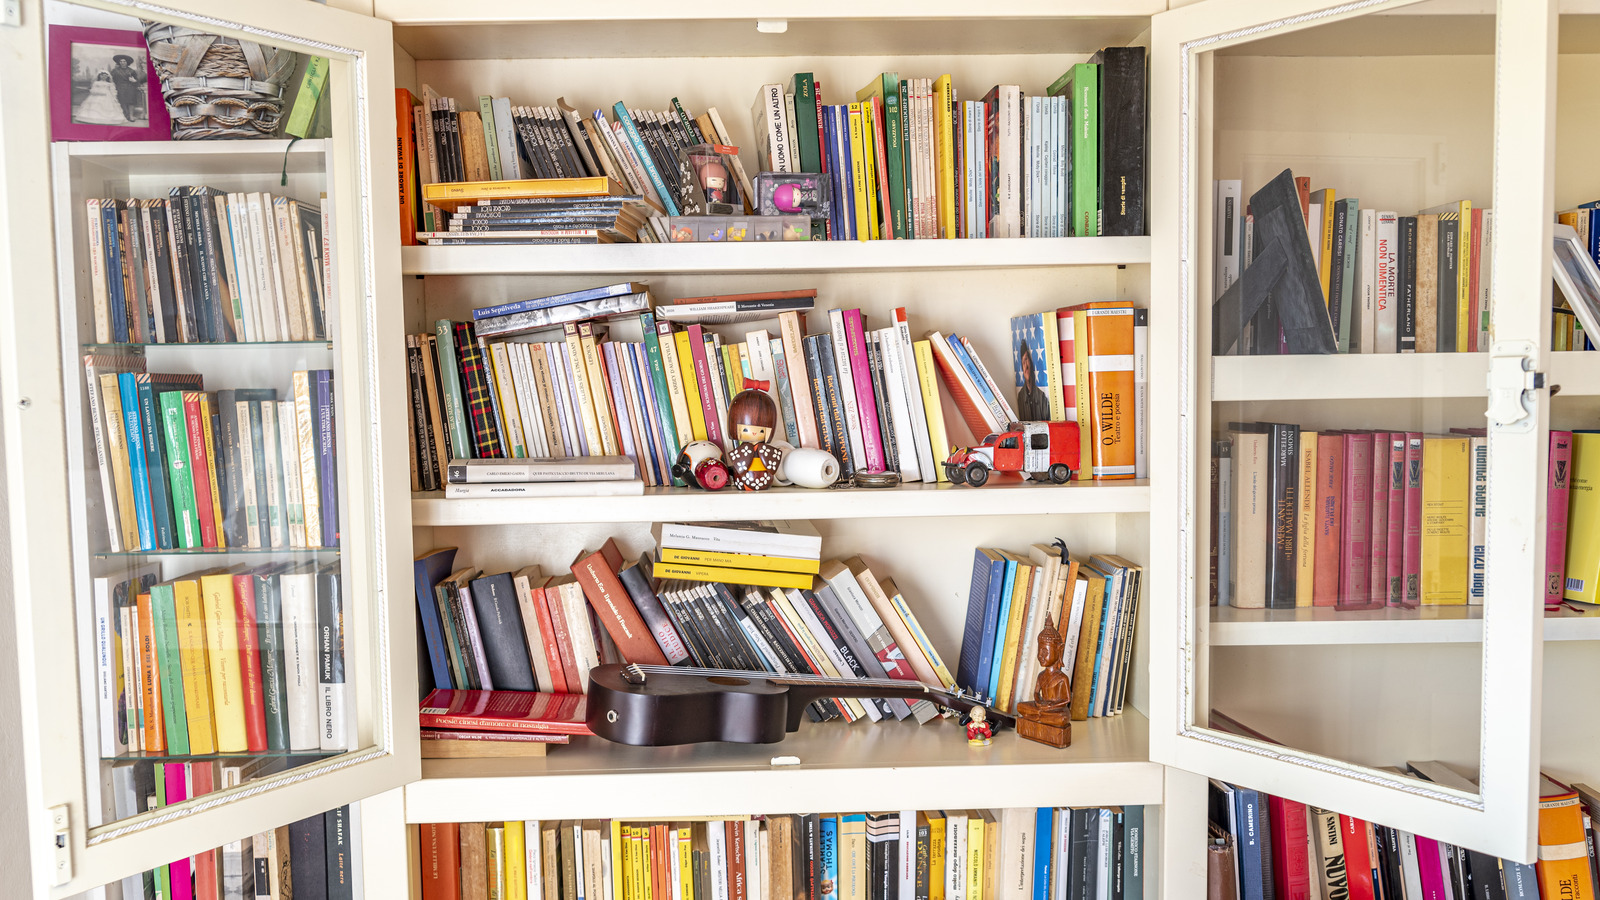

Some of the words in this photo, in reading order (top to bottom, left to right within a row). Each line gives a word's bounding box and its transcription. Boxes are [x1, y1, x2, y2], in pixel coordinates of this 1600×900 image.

[771, 88, 779, 109] ALTRO
[680, 112, 695, 137] CONRAD
[773, 110, 781, 119] UN
[775, 122, 783, 142] COME
[622, 115, 640, 144] coraggio,
[637, 144, 652, 166] charlie
[650, 166, 663, 188] brown!
[776, 144, 785, 164] UOMO
[400, 196, 404, 204] UN
[1379, 239, 1387, 259] NON
[1388, 252, 1396, 263] LA
[1378, 263, 1387, 311] DIMENTICA
[491, 303, 521, 315] Sepúlveda
[437, 325, 448, 335] 33
[848, 316, 859, 356] SHAKESPEARE
[703, 384, 711, 403] SCHIUMA
[1101, 392, 1113, 432] WILDE
[95, 427, 104, 466] STRANALANDIA
[1102, 434, 1114, 446] O.
[1301, 521, 1309, 535] figlia
[586, 563, 600, 584] Umberto
[605, 600, 618, 616] pendolo
[619, 620, 633, 639] Foucault
[750, 609, 765, 625] CHARLES
[761, 624, 773, 640] DICKENS
[808, 598, 826, 621] GIANLUCA
[822, 620, 839, 640] MOROZZI
[658, 631, 671, 648] MIO
[661, 623, 684, 657] GIUDICE
[669, 649, 677, 659] AL
[839, 645, 860, 672] BLACK
